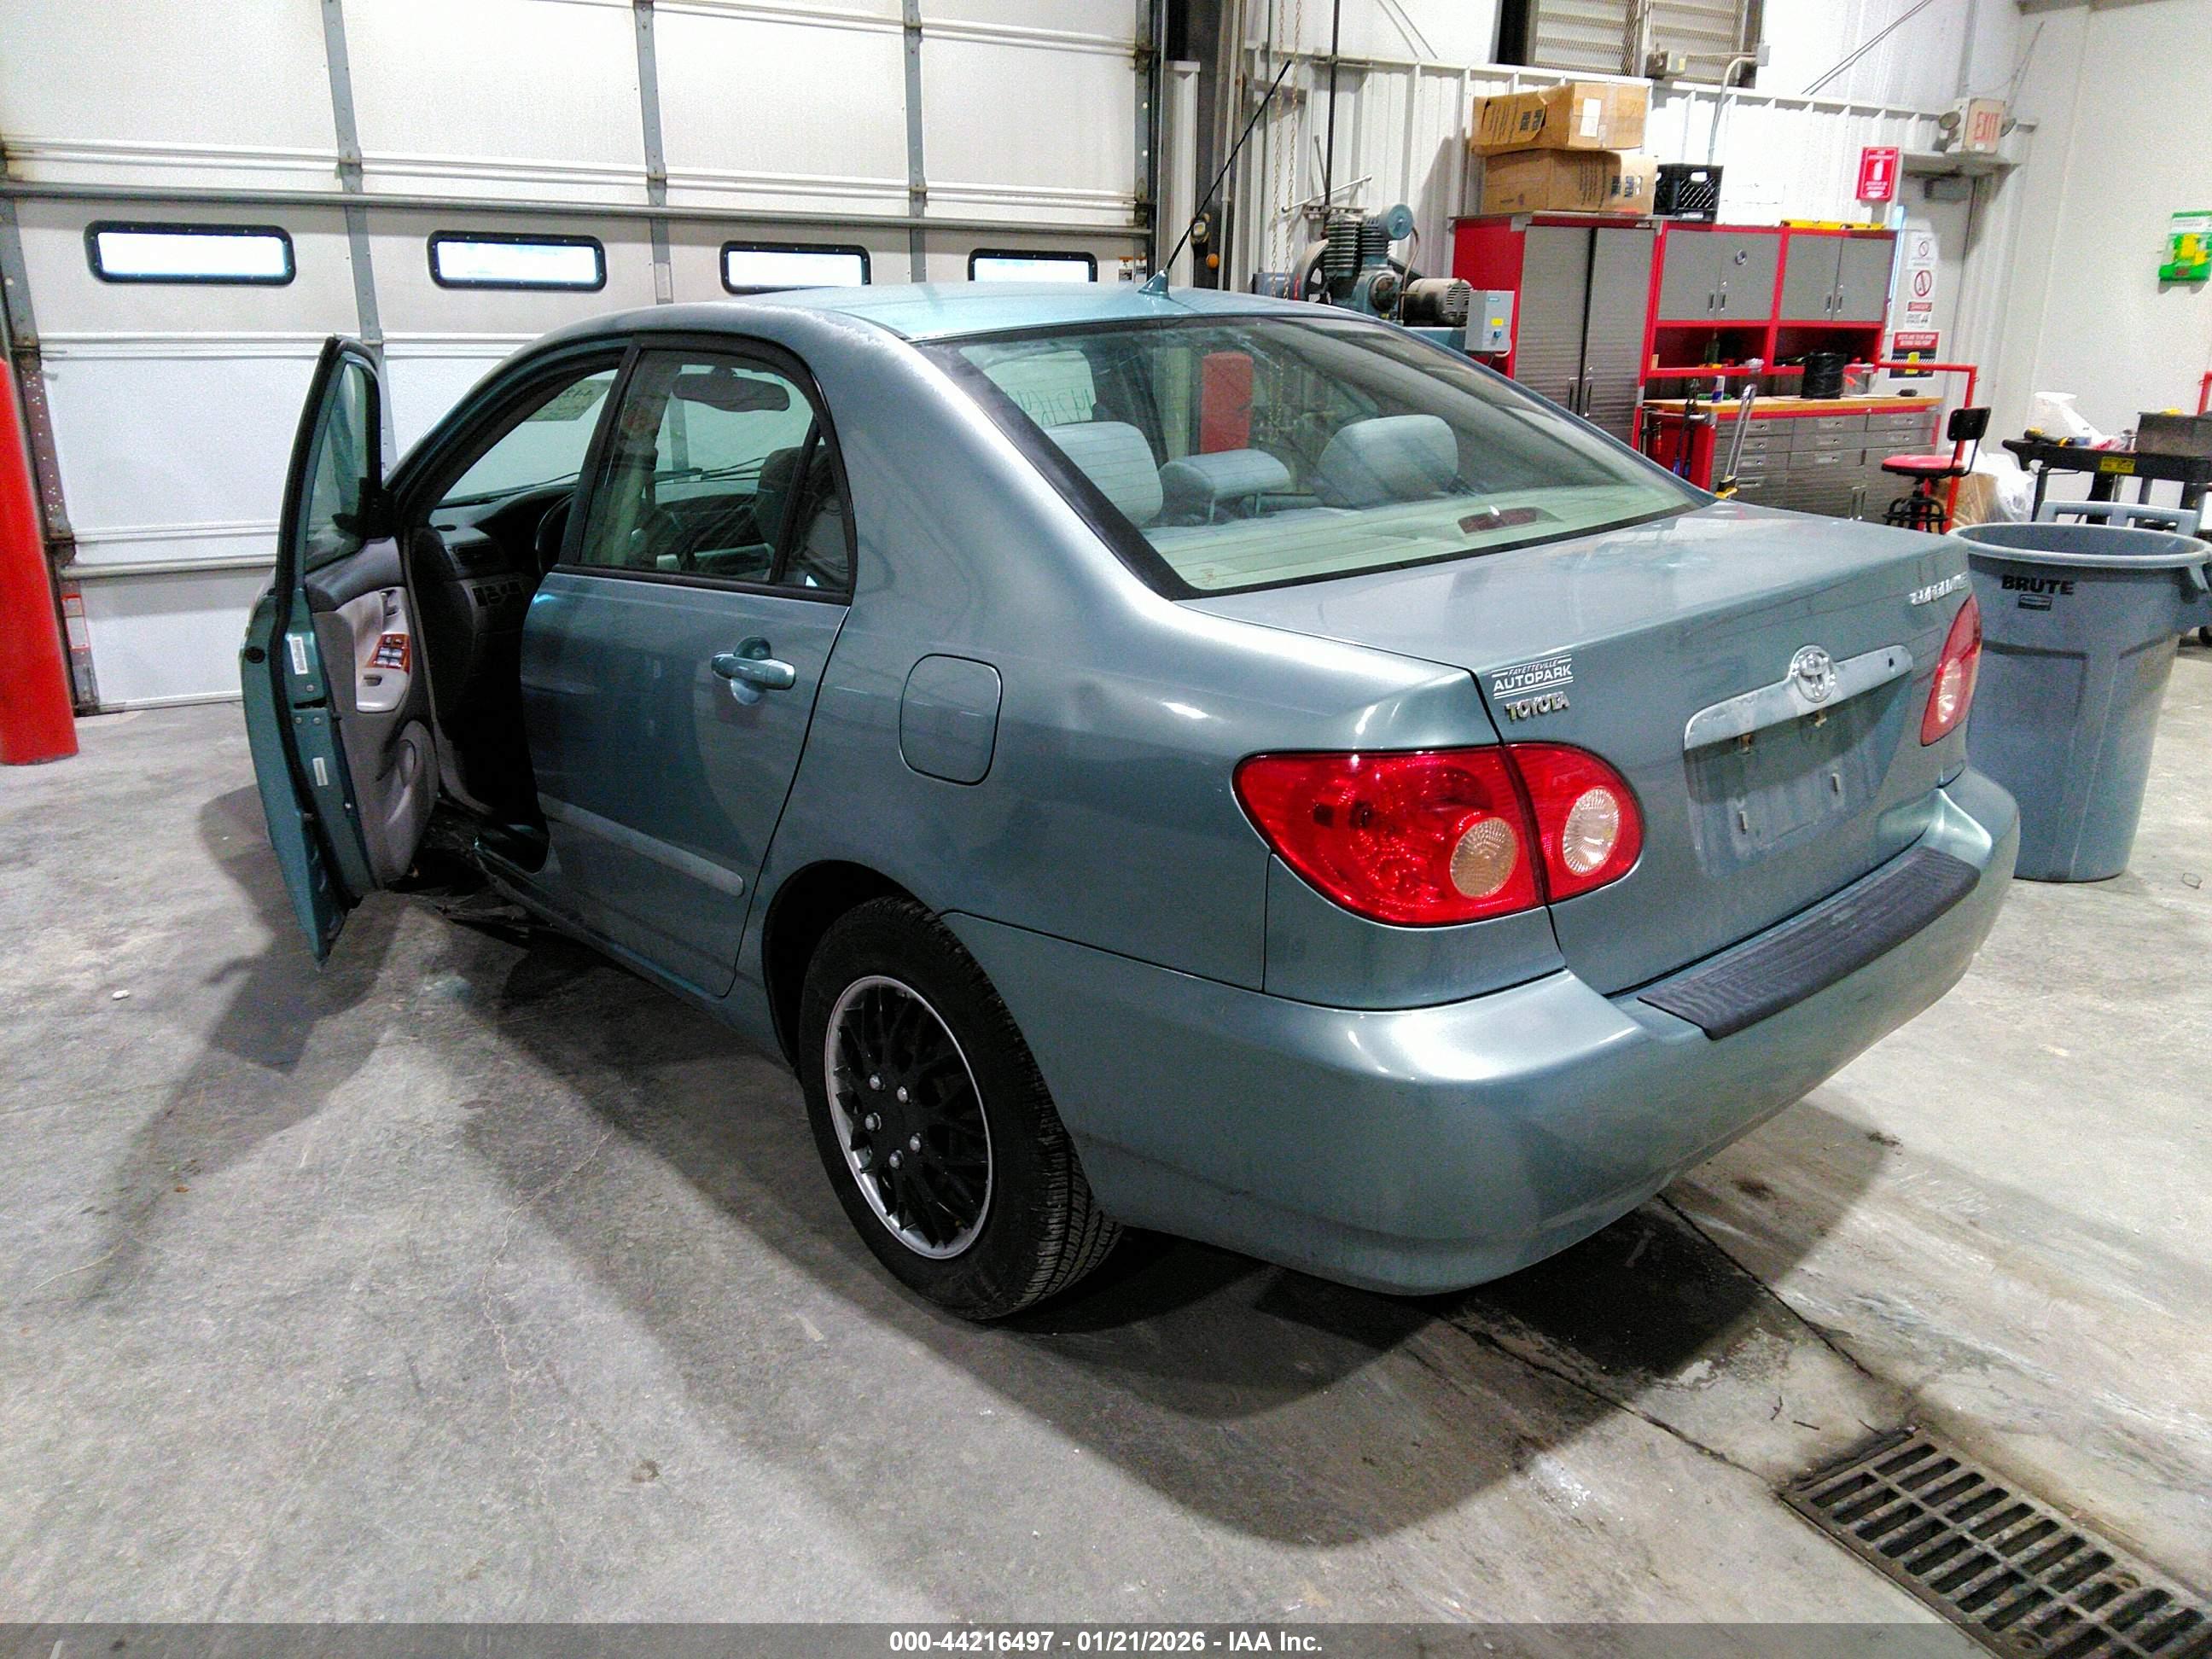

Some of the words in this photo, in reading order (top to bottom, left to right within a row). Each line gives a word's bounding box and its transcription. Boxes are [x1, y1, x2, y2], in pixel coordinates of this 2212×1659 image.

[1973, 111, 2000, 142] EXIT
[2001, 574, 2075, 596] BRUTE
[1493, 664, 1572, 692] AUTOPARK
[1508, 659, 1558, 676] FAYETTEVILLE
[1505, 690, 1571, 722] TOYOTA
